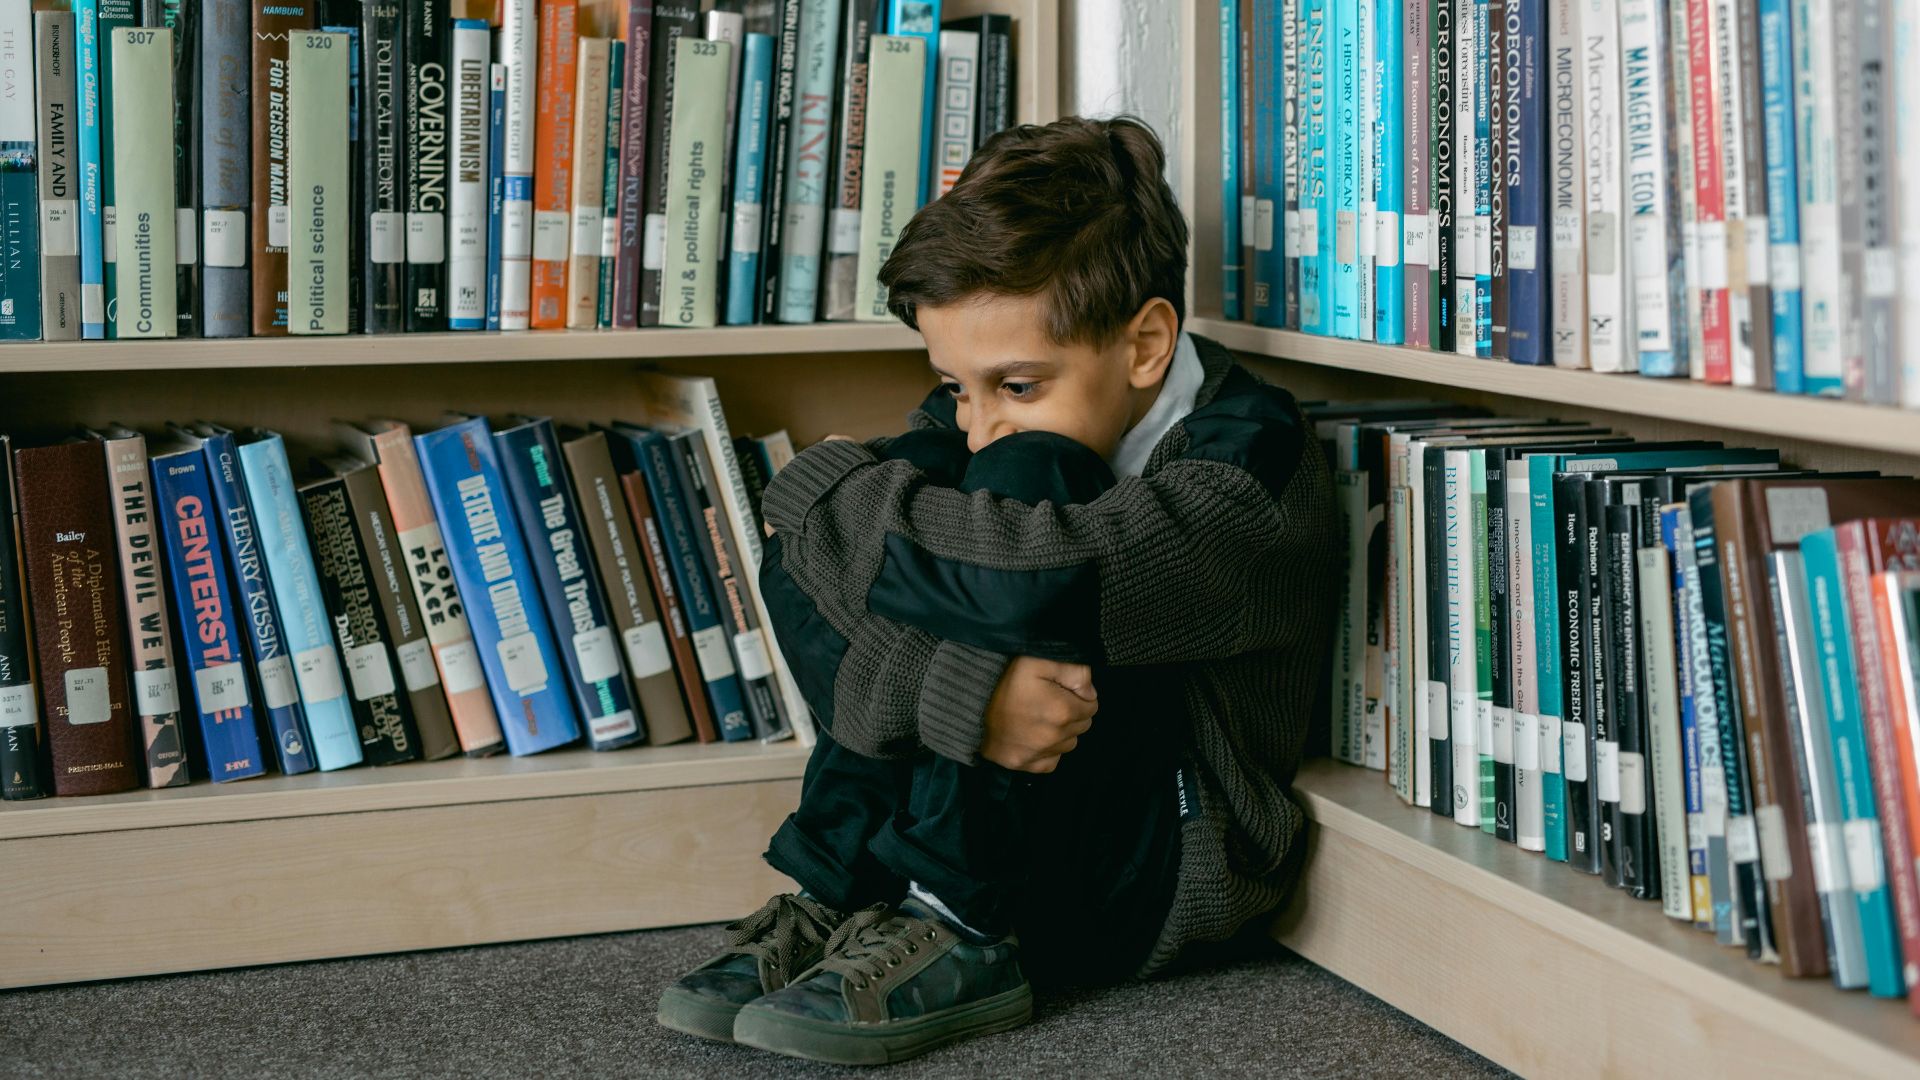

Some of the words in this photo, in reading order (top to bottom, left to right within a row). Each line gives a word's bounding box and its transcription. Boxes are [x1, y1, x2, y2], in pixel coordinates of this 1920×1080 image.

[81, 7, 94, 45] Single
[263, 6, 304, 16] HAMBURG
[424, 1, 432, 37] RANNEY
[556, 4, 575, 65] WOMEN
[1344, 28, 1352, 38] A
[1479, 4, 1487, 56] Economic
[52, 24, 60, 77] BRINKERHOFF
[127, 32, 155, 44] 307
[306, 36, 332, 49] 320
[693, 43, 717, 55] 323
[781, 31, 796, 70] LUTHER
[886, 40, 910, 52] 324
[1525, 36, 1533, 65] Second
[270, 58, 283, 86] FOR
[377, 39, 393, 129] POLITICAL
[1310, 8, 1324, 135] INSIDE
[1344, 44, 1353, 103] HISTORY
[1376, 60, 1385, 118] Nature
[1459, 37, 1472, 112] Forecasting
[1479, 59, 1487, 121] forecasting:
[1525, 68, 1533, 98] Edition
[85, 73, 96, 127] Children
[270, 92, 283, 159] DECISION
[459, 59, 482, 183] LIBERTARIANISM
[850, 63, 867, 145] NORTHERN
[1299, 19, 1308, 196] BUSINESS
[1345, 108, 1353, 127] OF
[1411, 79, 1420, 145] Economics
[1437, 0, 1450, 227] ICROECONOMICS
[1625, 46, 1652, 163] MANAGERIAL
[51, 103, 65, 157] FAMILY
[419, 62, 445, 212] GOVERNING
[627, 106, 643, 161] WOMEN
[797, 91, 829, 178] KING
[1375, 122, 1386, 191] Tourism
[1411, 148, 1420, 160] of
[1490, 31, 1503, 277] MICROECONOMICS
[53, 163, 66, 197] AND
[86, 161, 97, 215] Krueger
[378, 135, 395, 202] THEORY
[688, 141, 705, 190] rights
[1345, 132, 1353, 208] AMERICAN
[1412, 163, 1420, 185] Art
[1479, 138, 1488, 186] HOLDEN,
[310, 185, 324, 253] science
[623, 176, 639, 247] POLITICS
[1412, 188, 1420, 211] and
[1633, 171, 1657, 216] ECON
[8, 203, 21, 269] LILLIAN
[684, 196, 700, 263] political
[872, 242, 890, 316] Elecral
[882, 170, 896, 237] process
[136, 212, 151, 333] Communities
[310, 260, 324, 330] Political
[682, 269, 696, 281] &
[680, 287, 696, 324] Civil
[1476, 288, 1486, 341] Cambridge
[168, 463, 196, 476] Brown
[707, 397, 728, 434] HOW
[718, 433, 749, 512] CONGRESS
[122, 481, 148, 525] THE
[540, 493, 567, 530] The
[1446, 466, 1459, 548] BEYOND
[1566, 513, 1577, 544] Hayek
[56, 531, 86, 543] Bailey
[67, 550, 80, 565] of
[87, 549, 99, 559] A
[316, 494, 351, 588] AMERICAN
[329, 487, 366, 586] FRANKLIN
[476, 542, 513, 584] AND
[550, 529, 584, 582] Great
[1493, 508, 1505, 595] ENTREPRENEURSHIP
[1513, 518, 1521, 582] Innovation
[1588, 526, 1599, 576] Robinson
[52, 553, 68, 617] American
[72, 567, 86, 588] the
[129, 534, 161, 603] DEVIL
[228, 504, 263, 583] HENRY
[248, 591, 280, 661] KISSIN
[410, 546, 446, 626] PEACE
[431, 547, 464, 618] LONG
[1448, 555, 1460, 593] THE
[1620, 532, 1633, 605] DEPENDENCY
[88, 563, 109, 637] Diplomatic
[563, 580, 597, 634] Trans
[1478, 604, 1486, 623] and
[1514, 586, 1522, 608] and
[1591, 595, 1601, 614] The
[1623, 608, 1633, 625] TO
[57, 620, 76, 664] People
[140, 612, 164, 650] WE
[1449, 602, 1461, 666] LIMITS
[1515, 611, 1523, 649] Growth
[1567, 589, 1581, 667] ECONOMIC
[1592, 617, 1604, 680] International
[0, 653, 11, 681] ANN
[1517, 653, 1524, 664] in
[1624, 627, 1635, 693] ENTERPRISE
[1353, 683, 1363, 761] structure
[1594, 682, 1606, 720] Transfer
[387, 712, 408, 752] AND
[1597, 722, 1607, 737] of
[1686, 726, 1697, 768] Second
[68, 762, 124, 774] PRENTICE-HALL
[1691, 770, 1700, 812] Edition
[1179, 789, 1189, 817] STYLE
